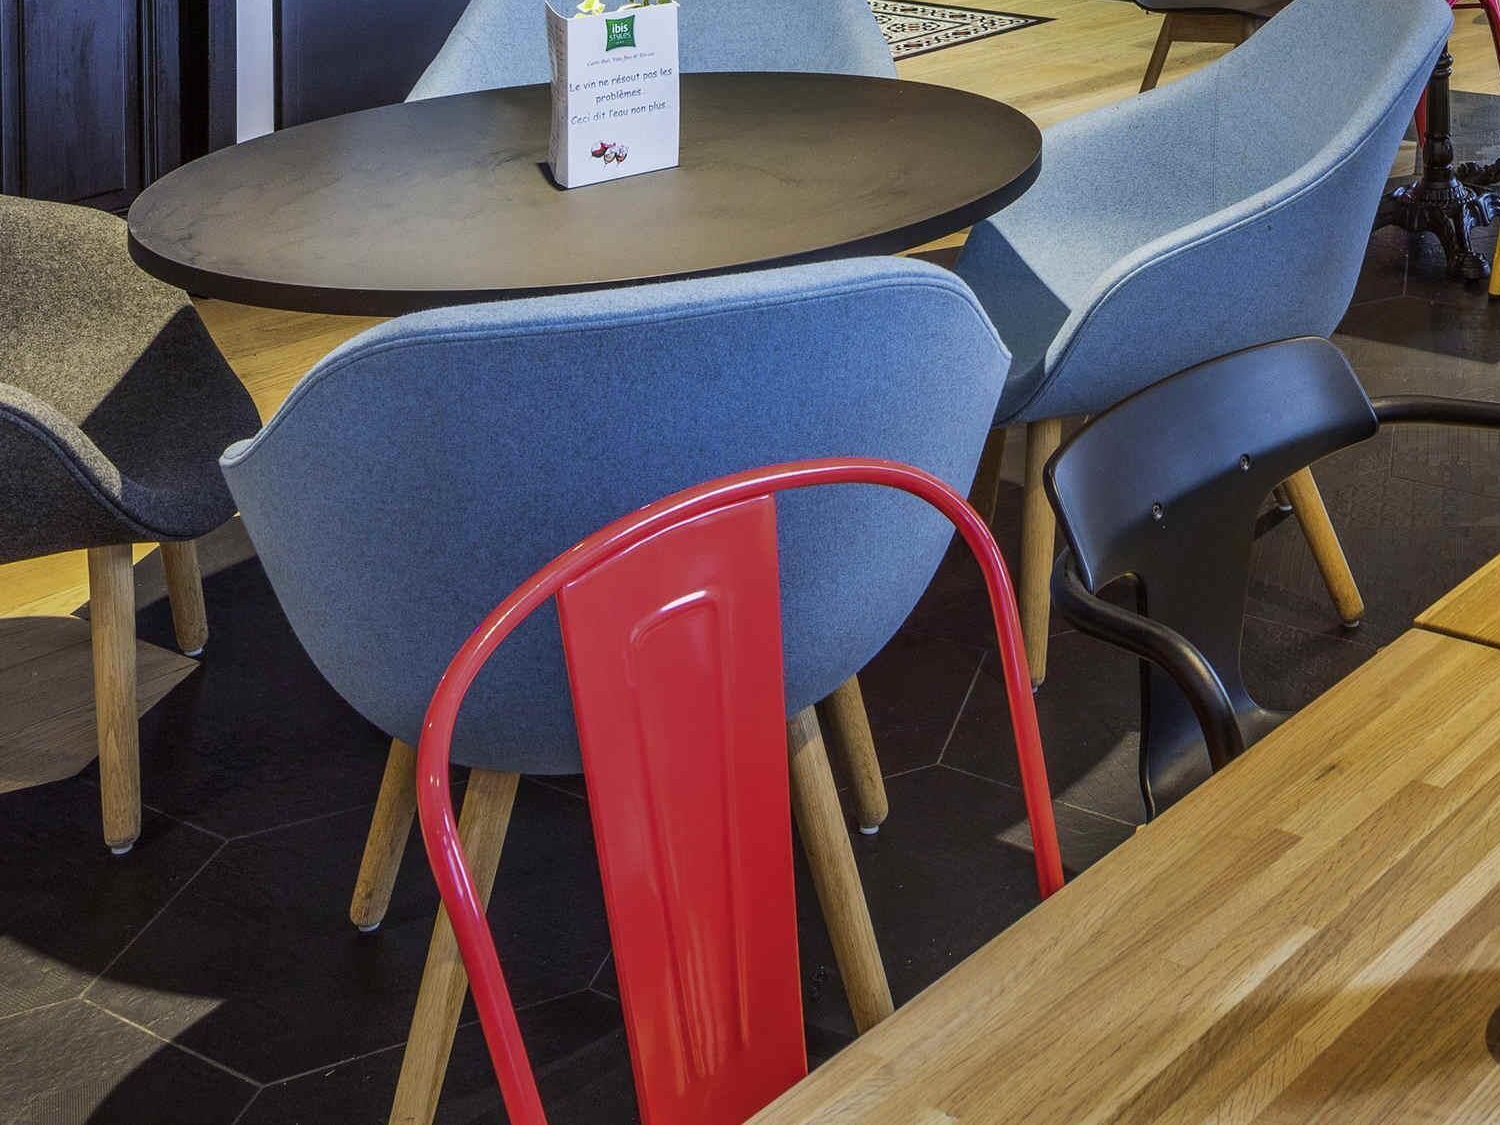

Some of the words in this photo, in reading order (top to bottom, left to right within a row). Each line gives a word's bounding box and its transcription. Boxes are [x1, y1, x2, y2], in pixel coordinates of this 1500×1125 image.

[612, 23, 628, 34] ibis
[569, 82, 580, 93] Le
[583, 81, 596, 90] vin
[598, 78, 609, 87] ne
[642, 70, 658, 82] pas
[660, 67, 673, 76] les
[595, 88, 642, 105] problèmes
[569, 114, 590, 125] Ceci
[593, 111, 605, 122] dit
[609, 108, 628, 119] l'eau
[631, 105, 646, 115] non
[648, 100, 666, 113] plus
